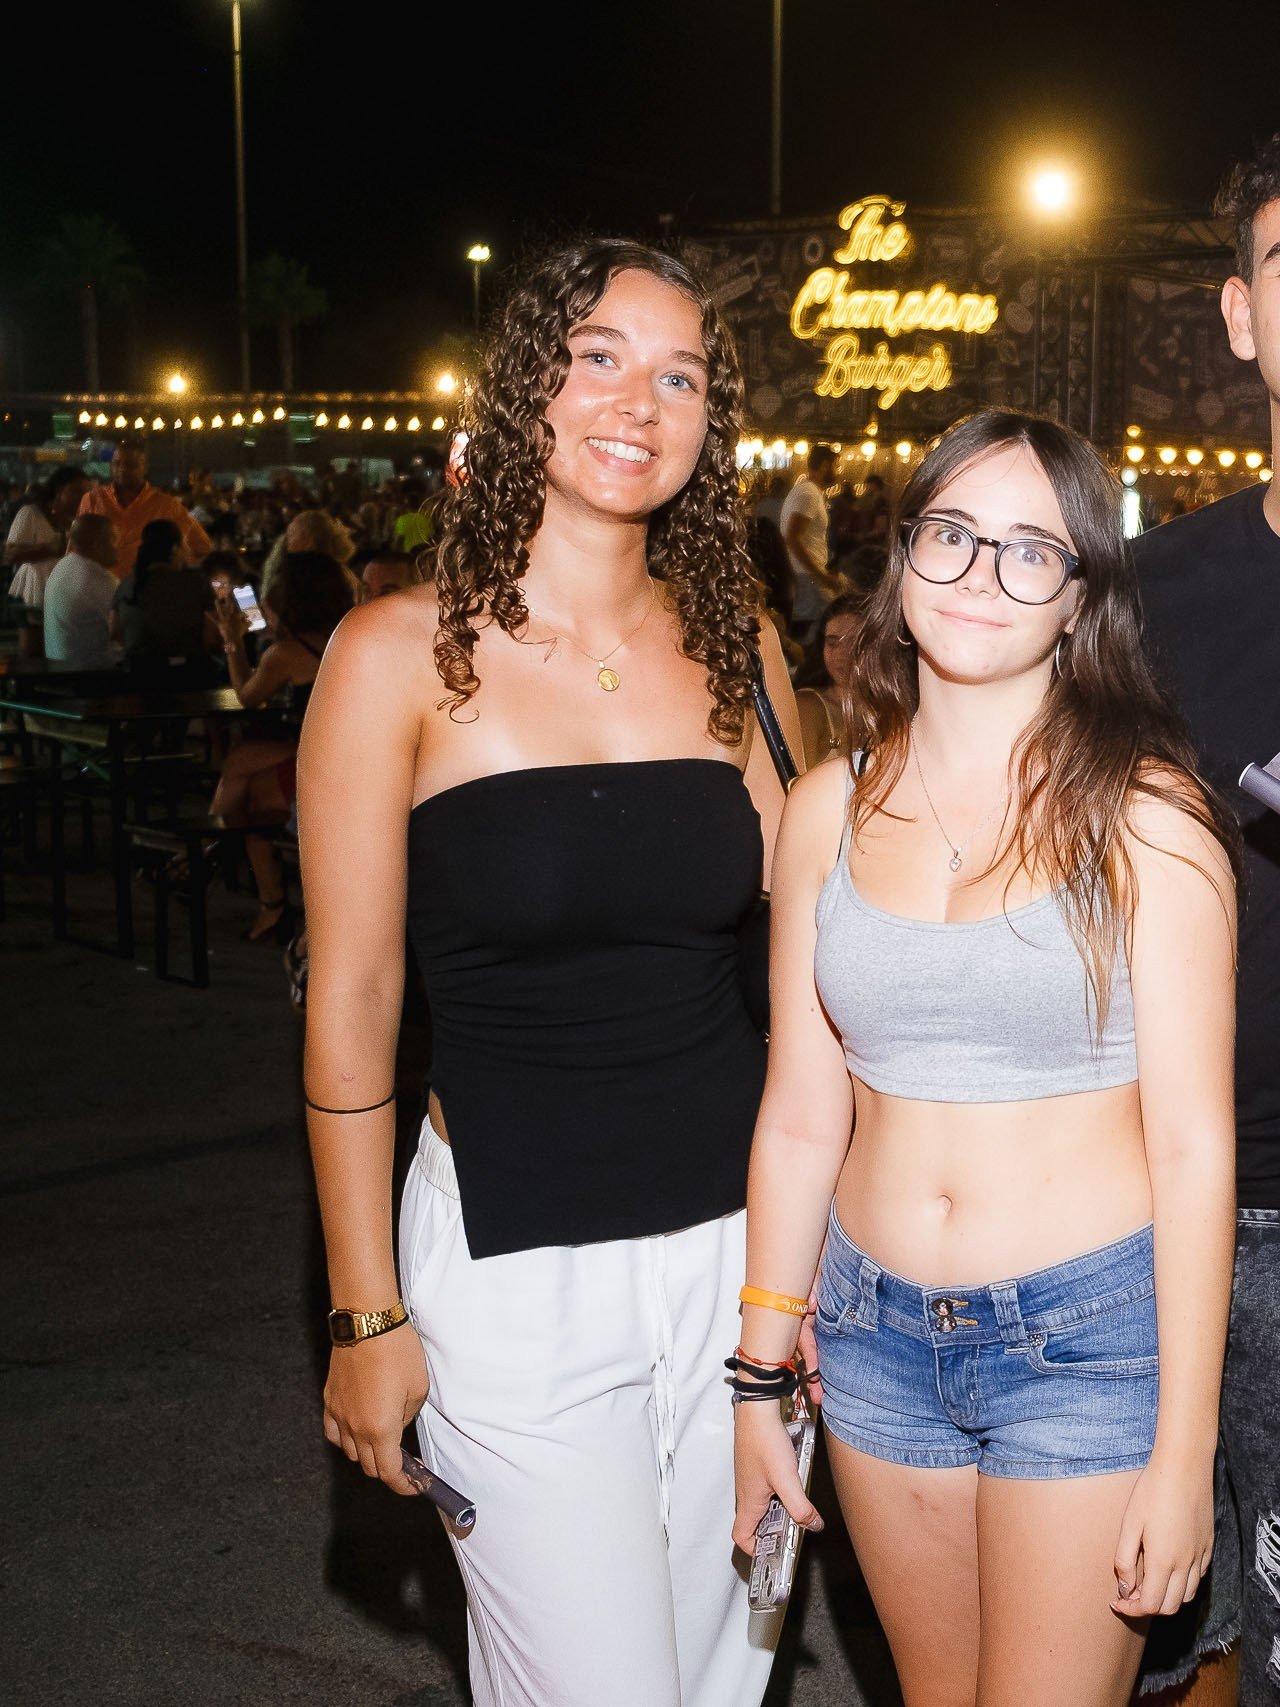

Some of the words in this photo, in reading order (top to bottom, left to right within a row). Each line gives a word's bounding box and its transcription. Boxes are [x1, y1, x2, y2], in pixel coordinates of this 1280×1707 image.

[834, 195, 911, 264] The
[790, 267, 999, 339] Champions
[815, 334, 952, 410] Burger
